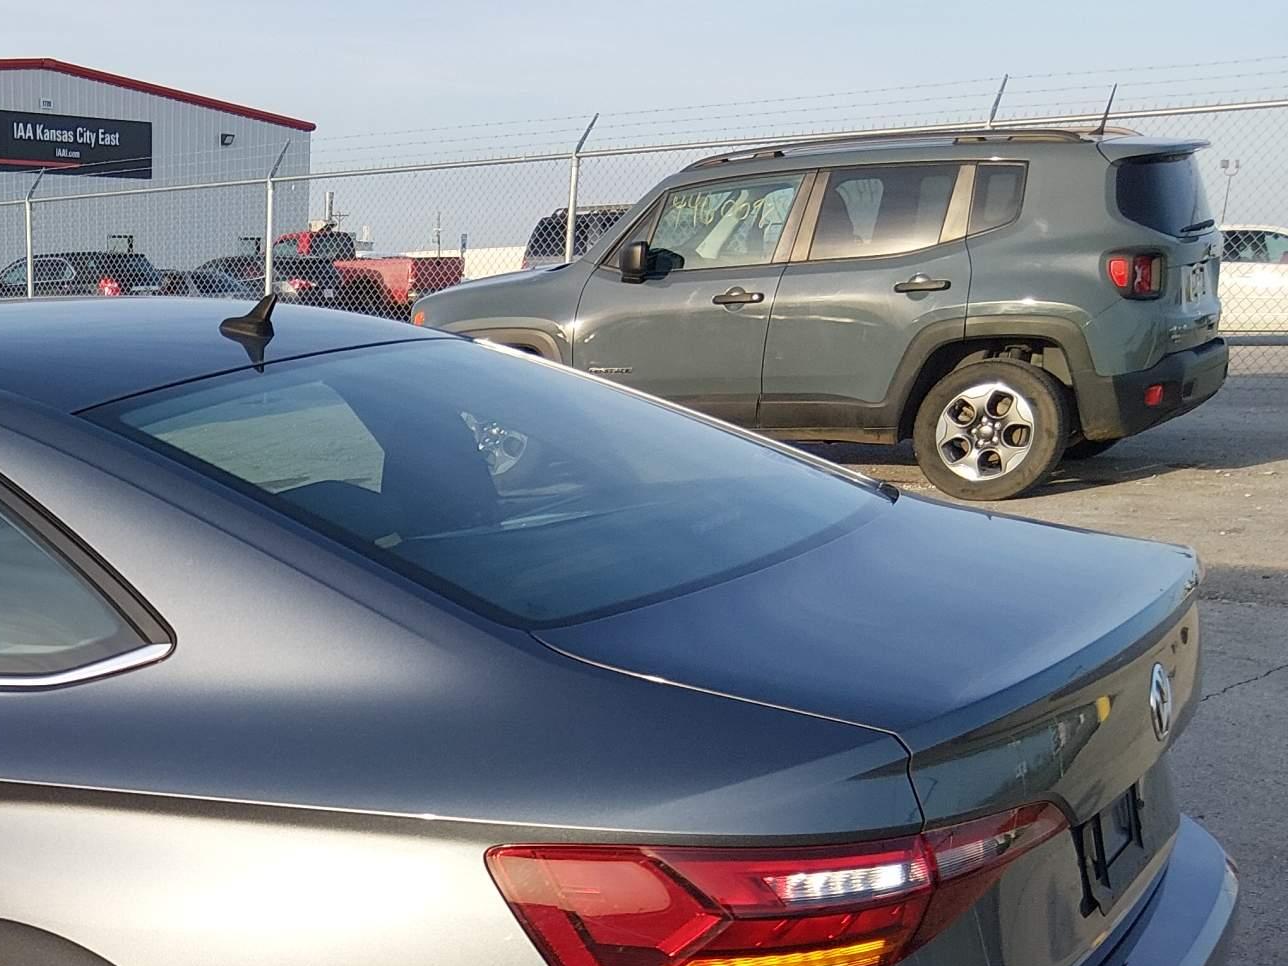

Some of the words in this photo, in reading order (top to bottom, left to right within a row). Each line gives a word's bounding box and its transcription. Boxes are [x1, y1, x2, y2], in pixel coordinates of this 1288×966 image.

[13, 122, 33, 140] IAA
[36, 123, 74, 143] Kansas
[76, 127, 96, 148] City
[98, 128, 120, 146] East
